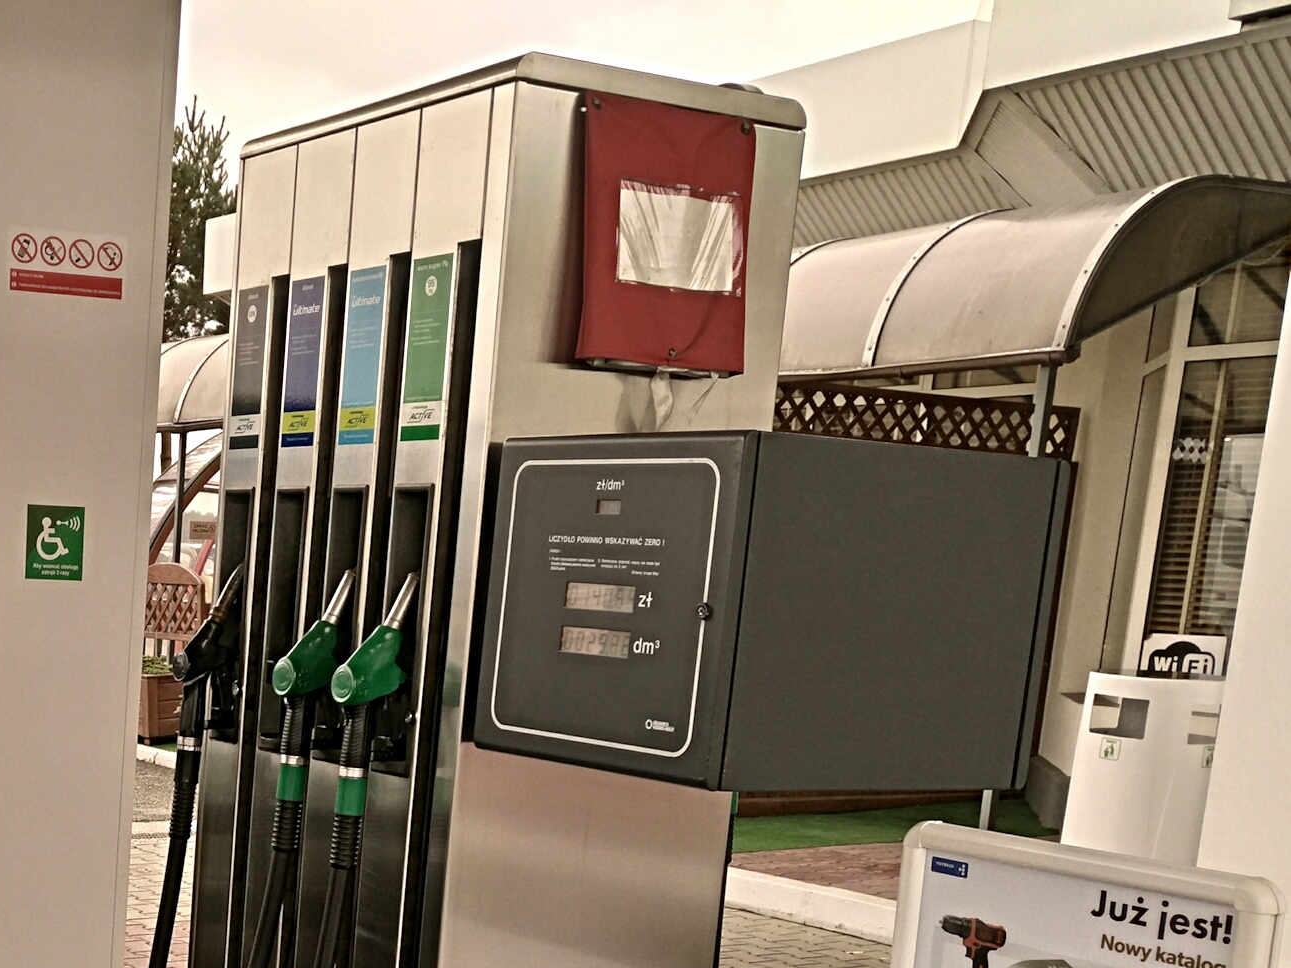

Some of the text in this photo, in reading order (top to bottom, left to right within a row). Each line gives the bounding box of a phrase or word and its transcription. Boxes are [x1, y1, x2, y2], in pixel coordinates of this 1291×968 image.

[429, 263, 441, 271] super
[428, 279, 435, 288] 95
[352, 294, 381, 308] ultimate
[293, 303, 320, 316] ultimate
[549, 535, 575, 543] LICZYDŁO
[577, 536, 603, 544] POWINNO
[605, 536, 643, 545] WSKAZYWAĆ
[638, 591, 653, 608] zł
[633, 637, 660, 655] dm³
[1091, 890, 1234, 945] Już jest!
[1101, 934, 1152, 962] Nowy
